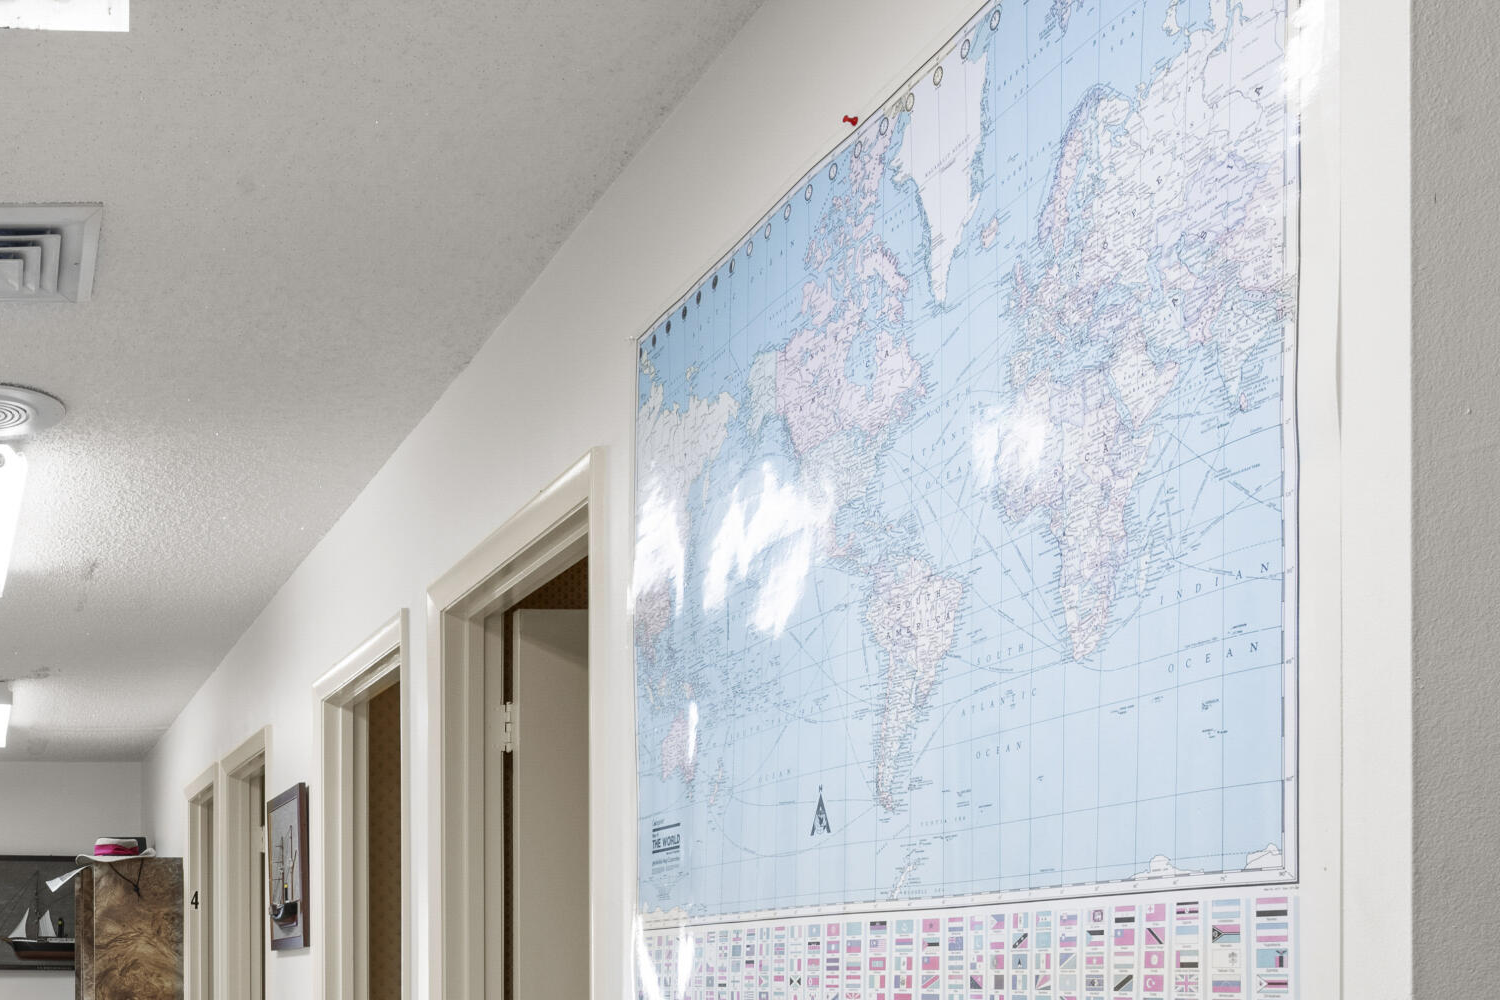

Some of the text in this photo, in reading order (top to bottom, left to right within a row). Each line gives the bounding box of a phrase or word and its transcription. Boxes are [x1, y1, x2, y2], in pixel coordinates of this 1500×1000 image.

[1159, 560, 1270, 605] INDIAN
[975, 642, 1024, 666] SOUTH
[1166, 641, 1258, 673] OCEAN
[652, 838, 661, 849] THE
[663, 834, 680, 847] WORLD
[190, 890, 199, 910] 4
